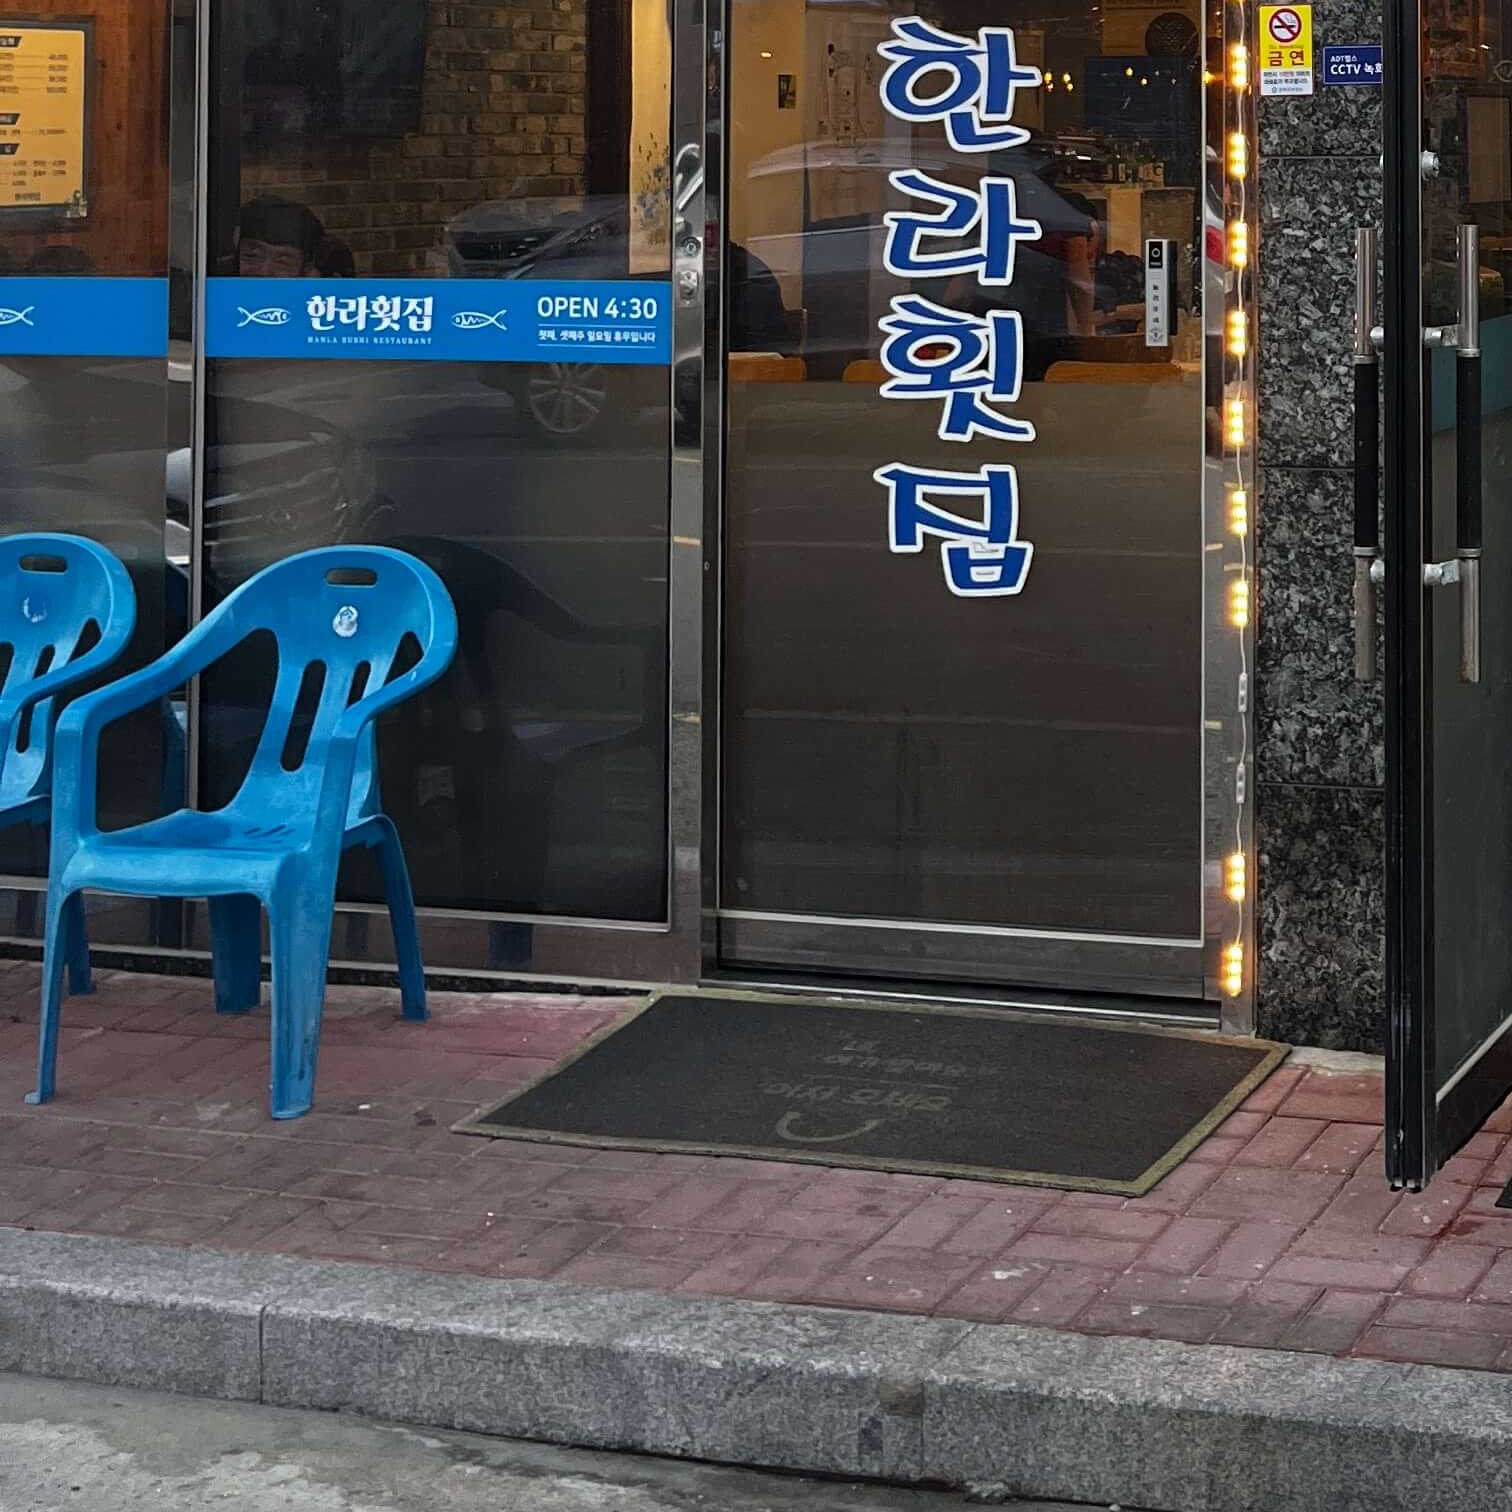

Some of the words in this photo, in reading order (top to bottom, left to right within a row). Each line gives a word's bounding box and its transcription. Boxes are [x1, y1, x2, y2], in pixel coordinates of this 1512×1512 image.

[1330, 63, 1361, 75] CCTV
[306, 295, 434, 333] 한라횟집
[537, 296, 599, 319] OPEN
[604, 297, 658, 320] 4:30
[872, 15, 1042, 598] 한라횟집
[373, 336, 433, 345] RESTAURANT
[587, 330, 612, 343] 일요일
[614, 331, 656, 343] 휴무입니다
